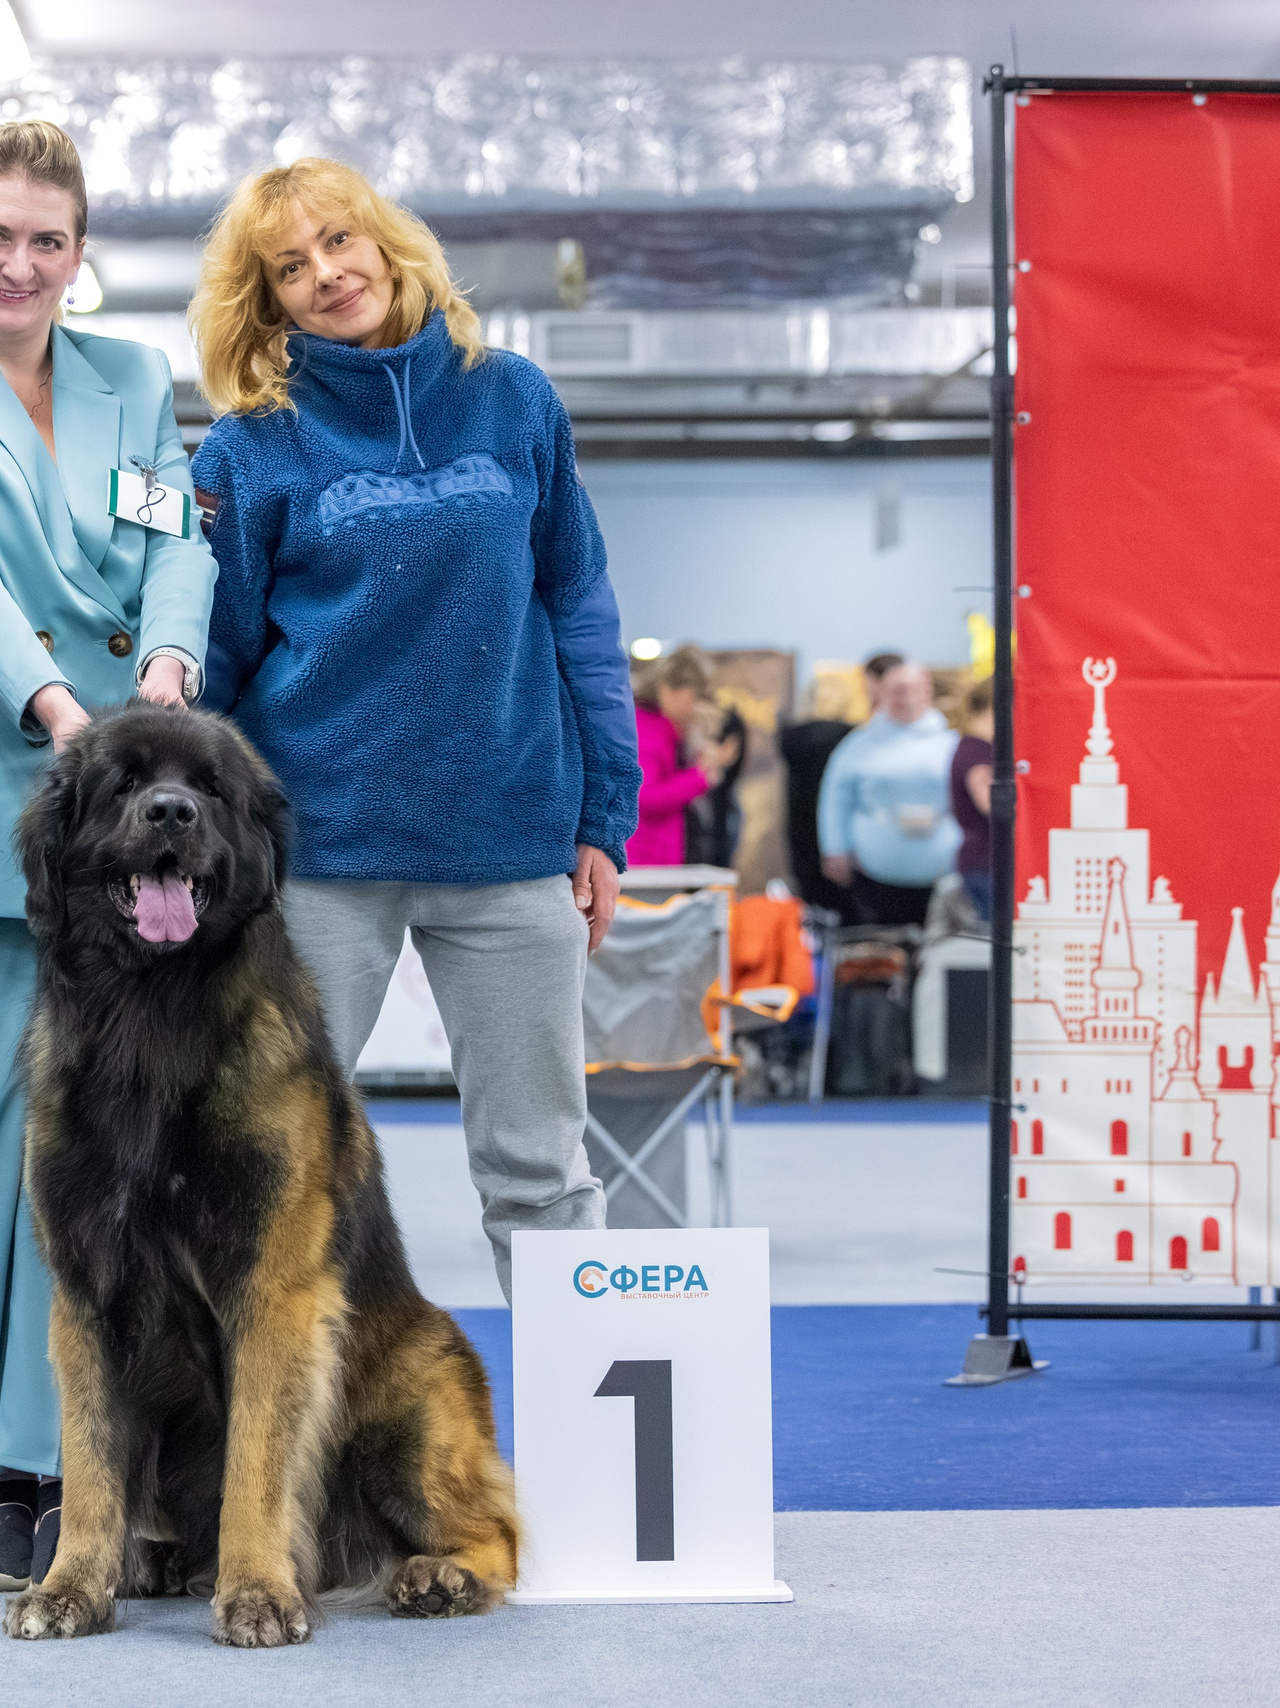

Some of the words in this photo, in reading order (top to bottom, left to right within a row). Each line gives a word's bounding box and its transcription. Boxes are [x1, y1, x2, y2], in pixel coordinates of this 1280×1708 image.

[573, 1260, 709, 1298] СФЕРА
[620, 1291, 681, 1300] ВЫСТАВОЧНЫЙ
[683, 1291, 710, 1300] ЦЕНТР
[593, 1359, 675, 1562] 1
